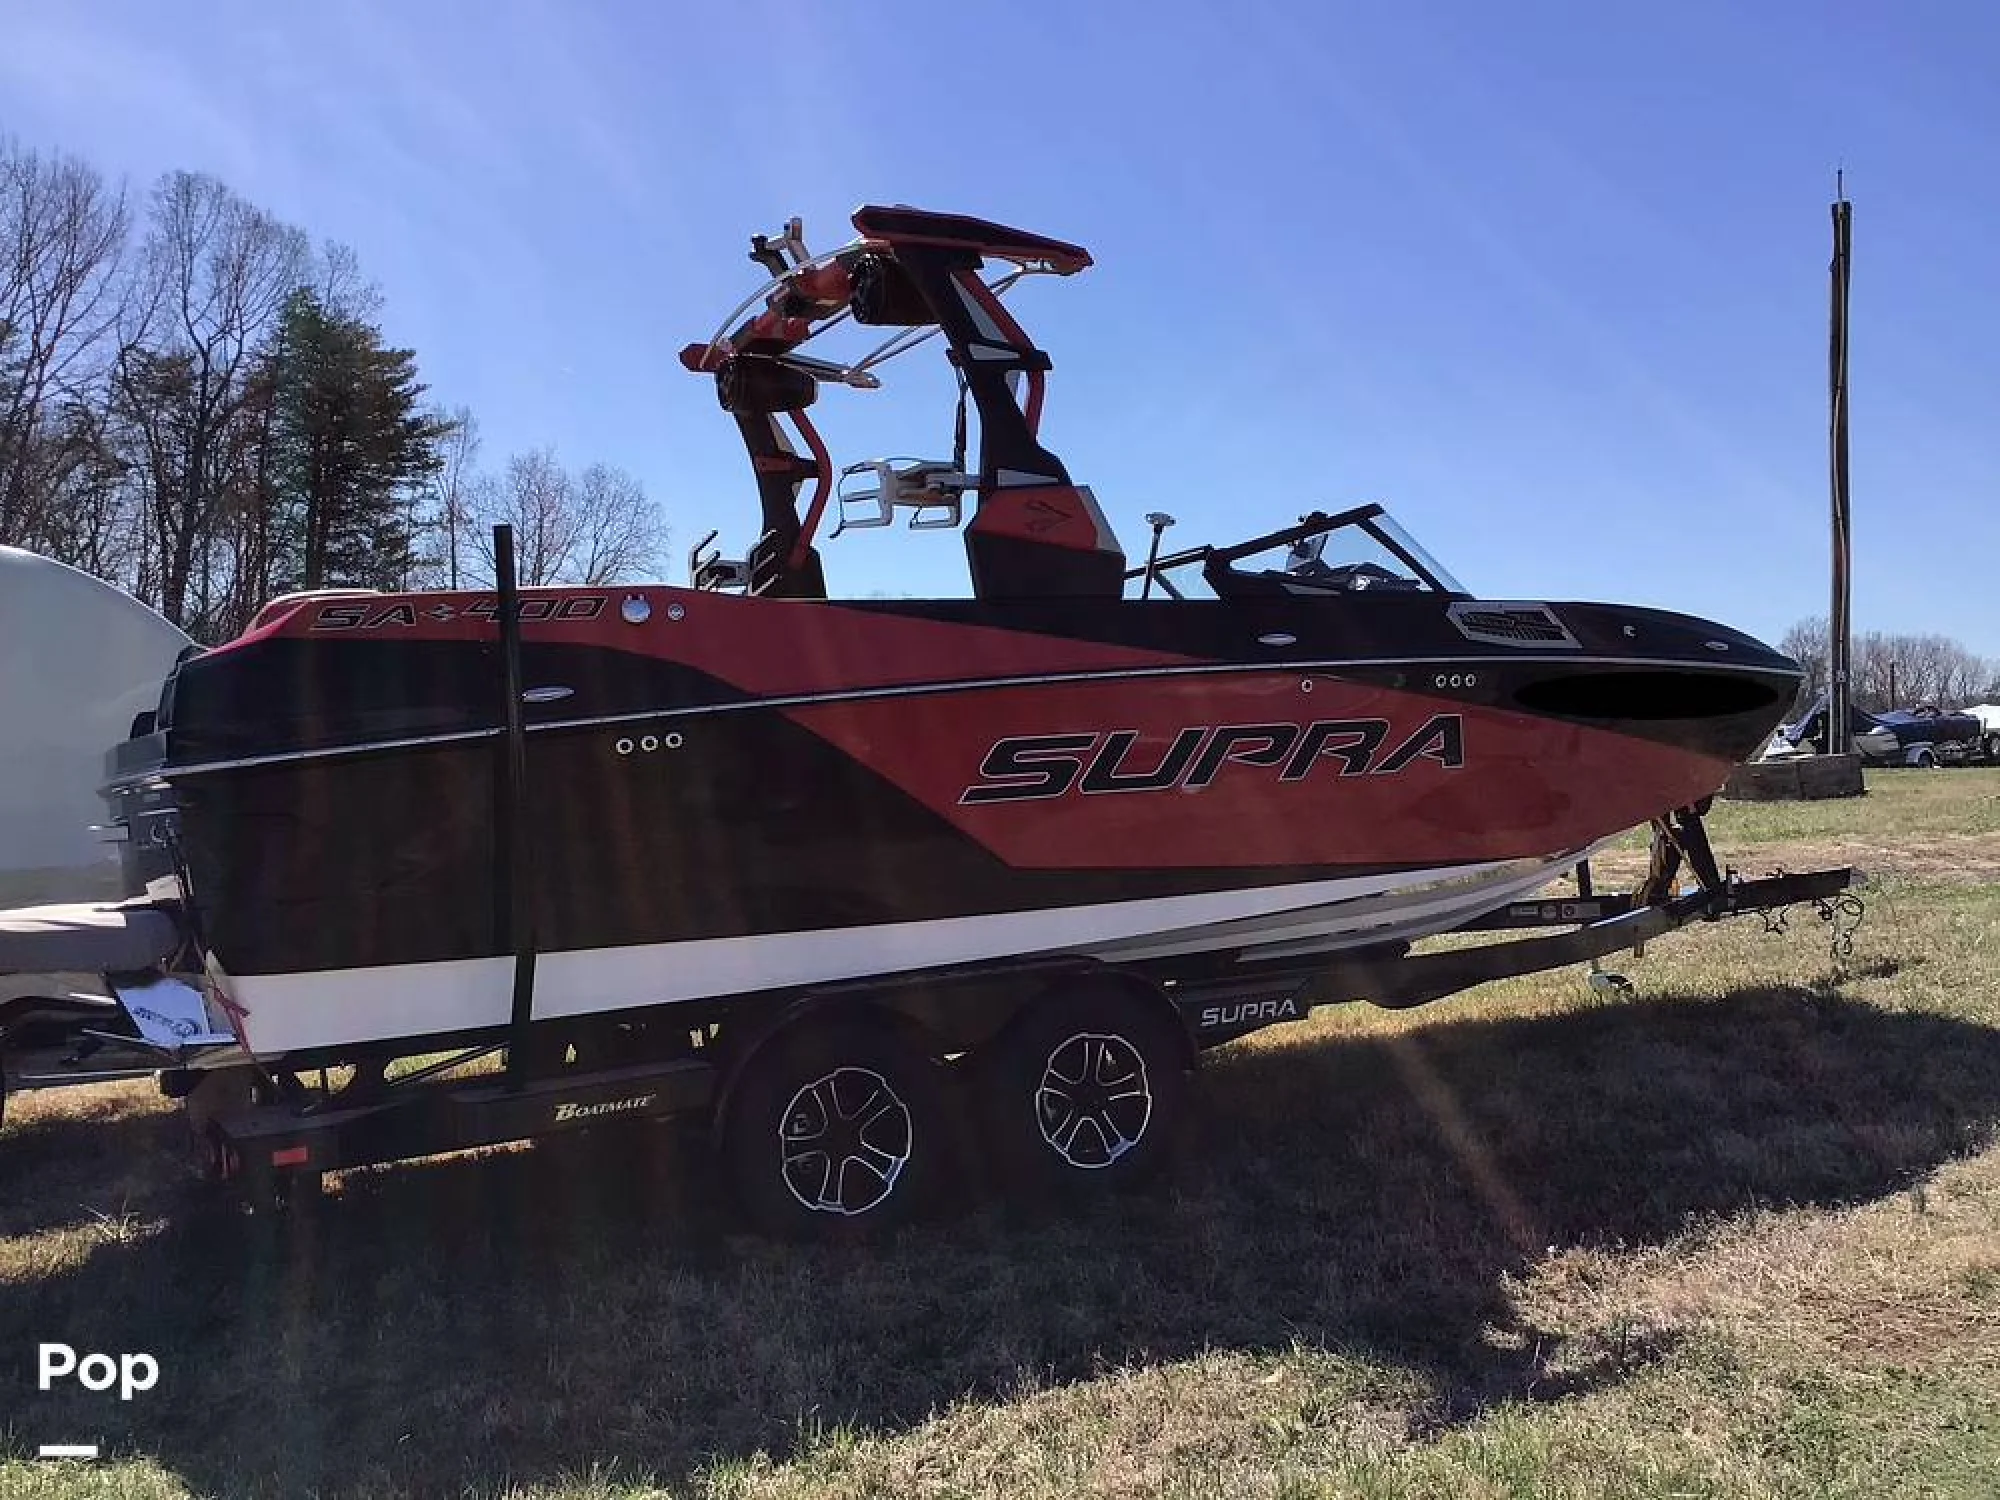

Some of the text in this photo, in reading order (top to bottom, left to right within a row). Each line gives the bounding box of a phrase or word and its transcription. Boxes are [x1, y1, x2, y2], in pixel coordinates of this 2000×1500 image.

[310, 595, 609, 631] SA 400
[958, 713, 1465, 805] SUPRA
[1200, 999, 1297, 1026] SUPRA
